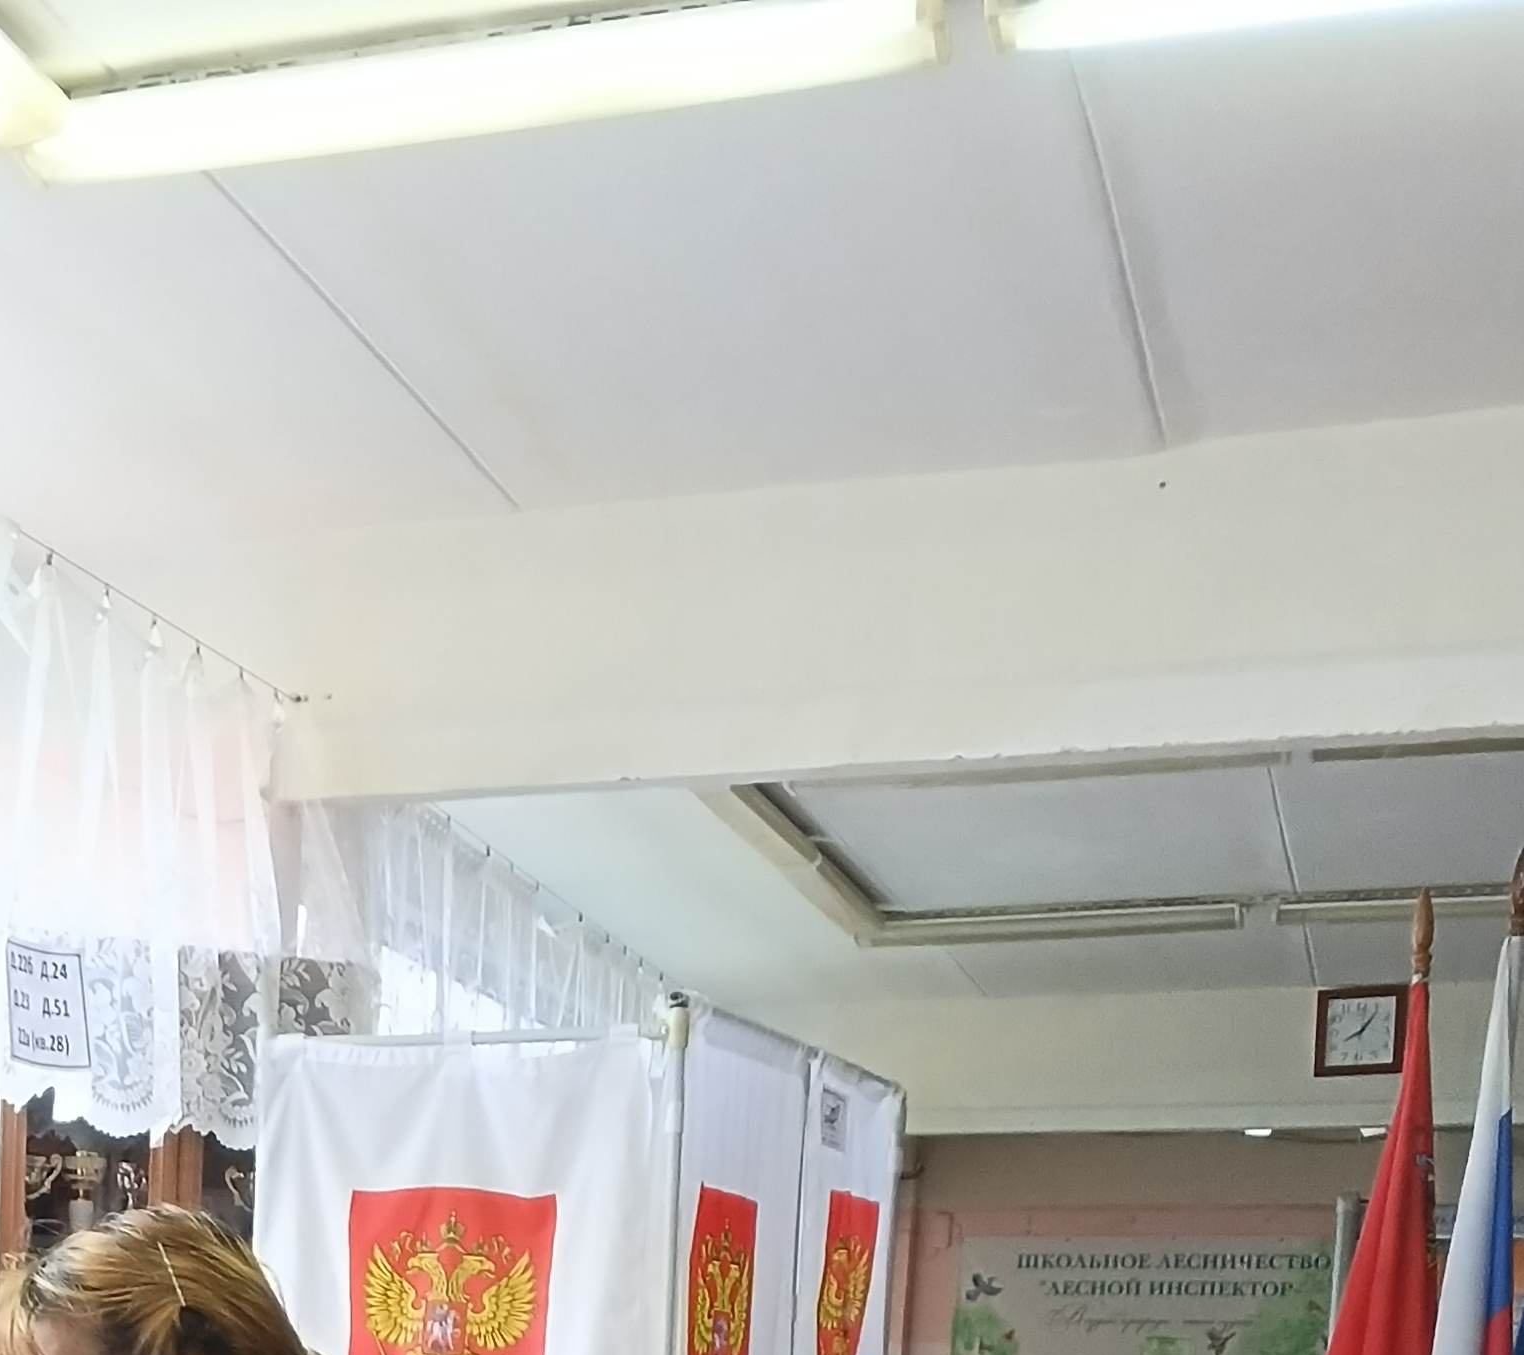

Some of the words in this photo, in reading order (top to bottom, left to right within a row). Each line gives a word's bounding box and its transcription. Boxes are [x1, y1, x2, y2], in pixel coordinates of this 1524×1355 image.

[40, 960, 69, 982] Д.24
[42, 997, 71, 1018] Д.51
[1016, 1253, 1152, 1270] ШКОЛЬНОЕ
[1154, 1253, 1332, 1270] ЛЕСНИЧЕСТВО
